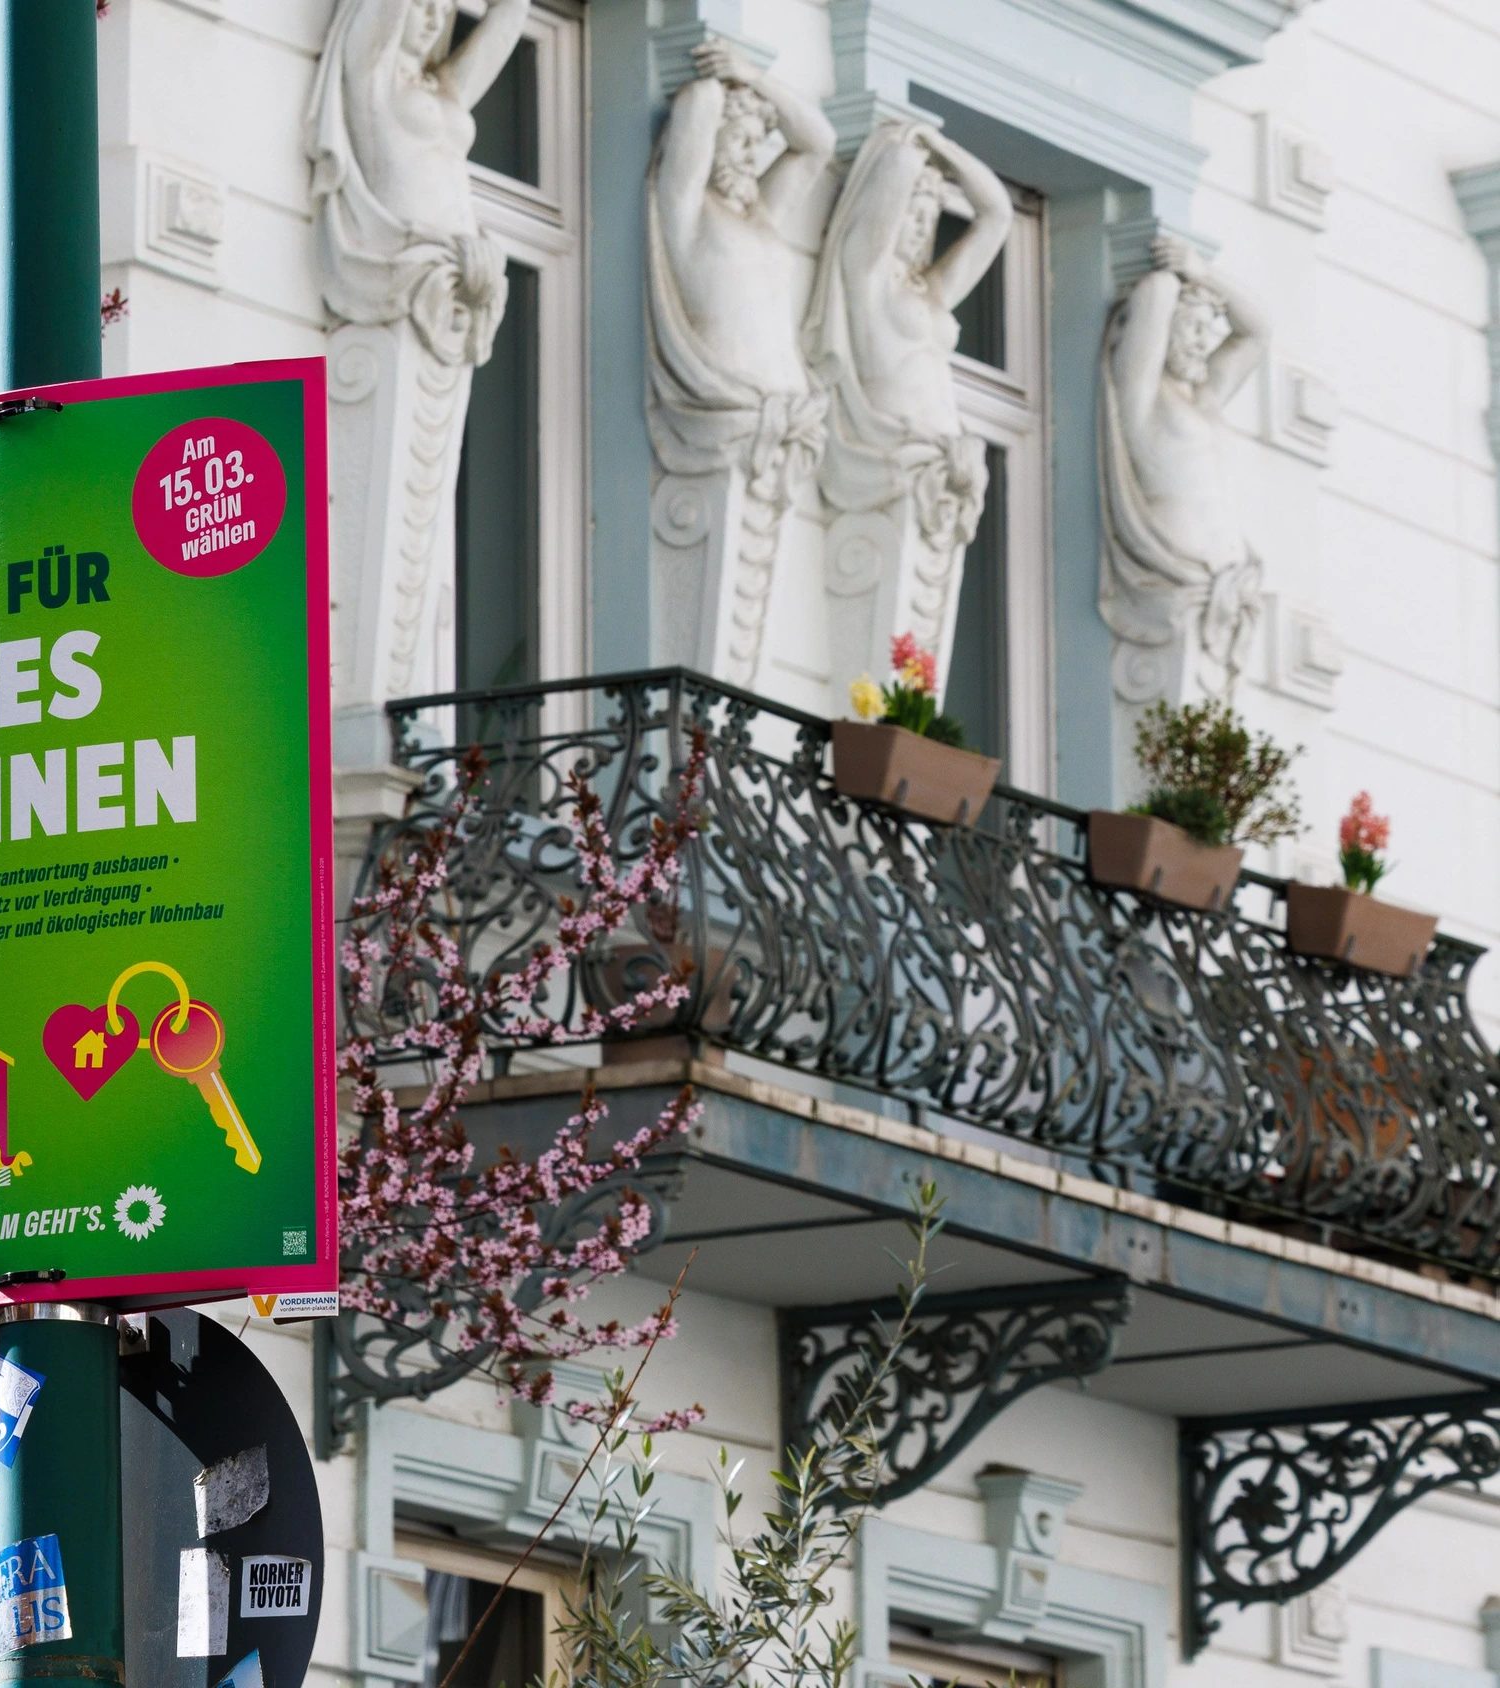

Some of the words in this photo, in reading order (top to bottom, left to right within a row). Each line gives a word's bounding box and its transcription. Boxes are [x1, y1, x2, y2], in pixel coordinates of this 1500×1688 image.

[182, 436, 215, 464] Am
[185, 492, 242, 533] GRÜN
[181, 520, 255, 561] wählen
[7, 544, 111, 615] FÜR
[92, 854, 168, 875] ausbauen
[15, 894, 39, 911] vor
[43, 883, 141, 908] Verdrängung
[15, 917, 43, 938] und
[46, 908, 146, 934] ökologischer
[149, 902, 225, 924] Wohnbau
[280, 1297, 336, 1306] VORDERMANN
[250, 1563, 304, 1586] KORNER
[249, 1585, 301, 1609] TOYOTA
